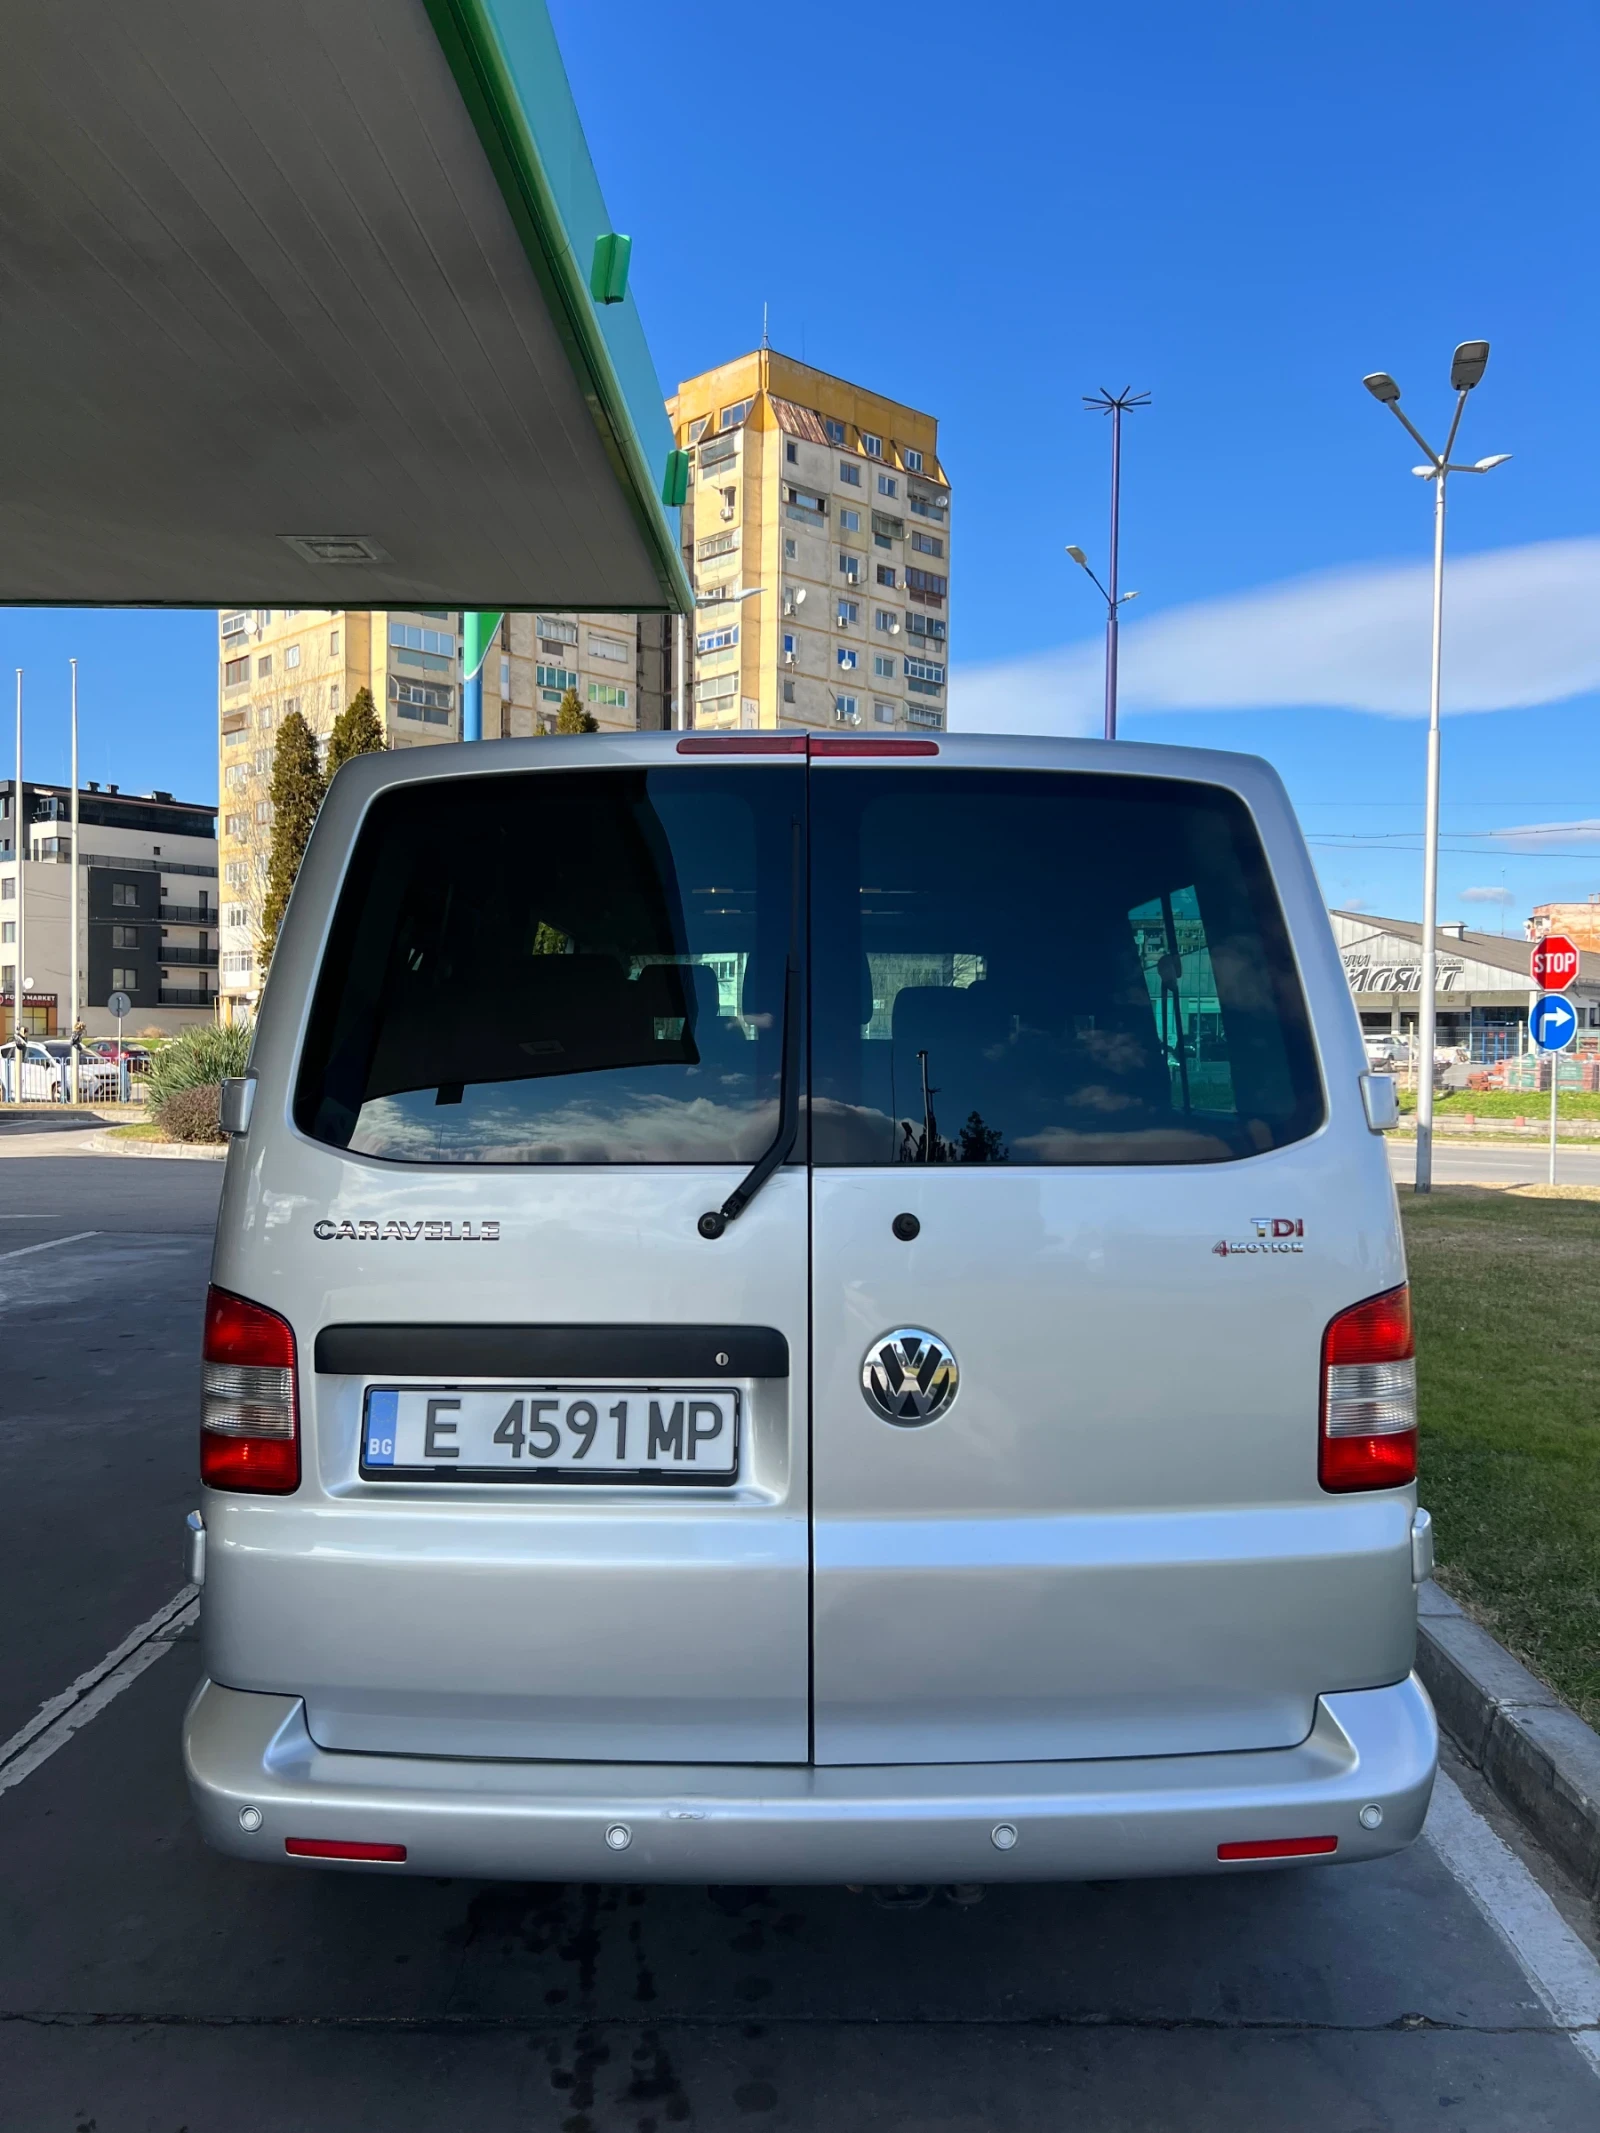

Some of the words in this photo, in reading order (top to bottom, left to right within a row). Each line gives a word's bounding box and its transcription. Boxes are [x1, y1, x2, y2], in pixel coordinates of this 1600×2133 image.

[1534, 952, 1576, 974] STOP
[313, 1219, 500, 1241] CARAVELLE
[1250, 1217, 1304, 1238] TDI
[1212, 1240, 1304, 1257] 4MOTION
[424, 1399, 461, 1458] E
[368, 1437, 392, 1456] BG
